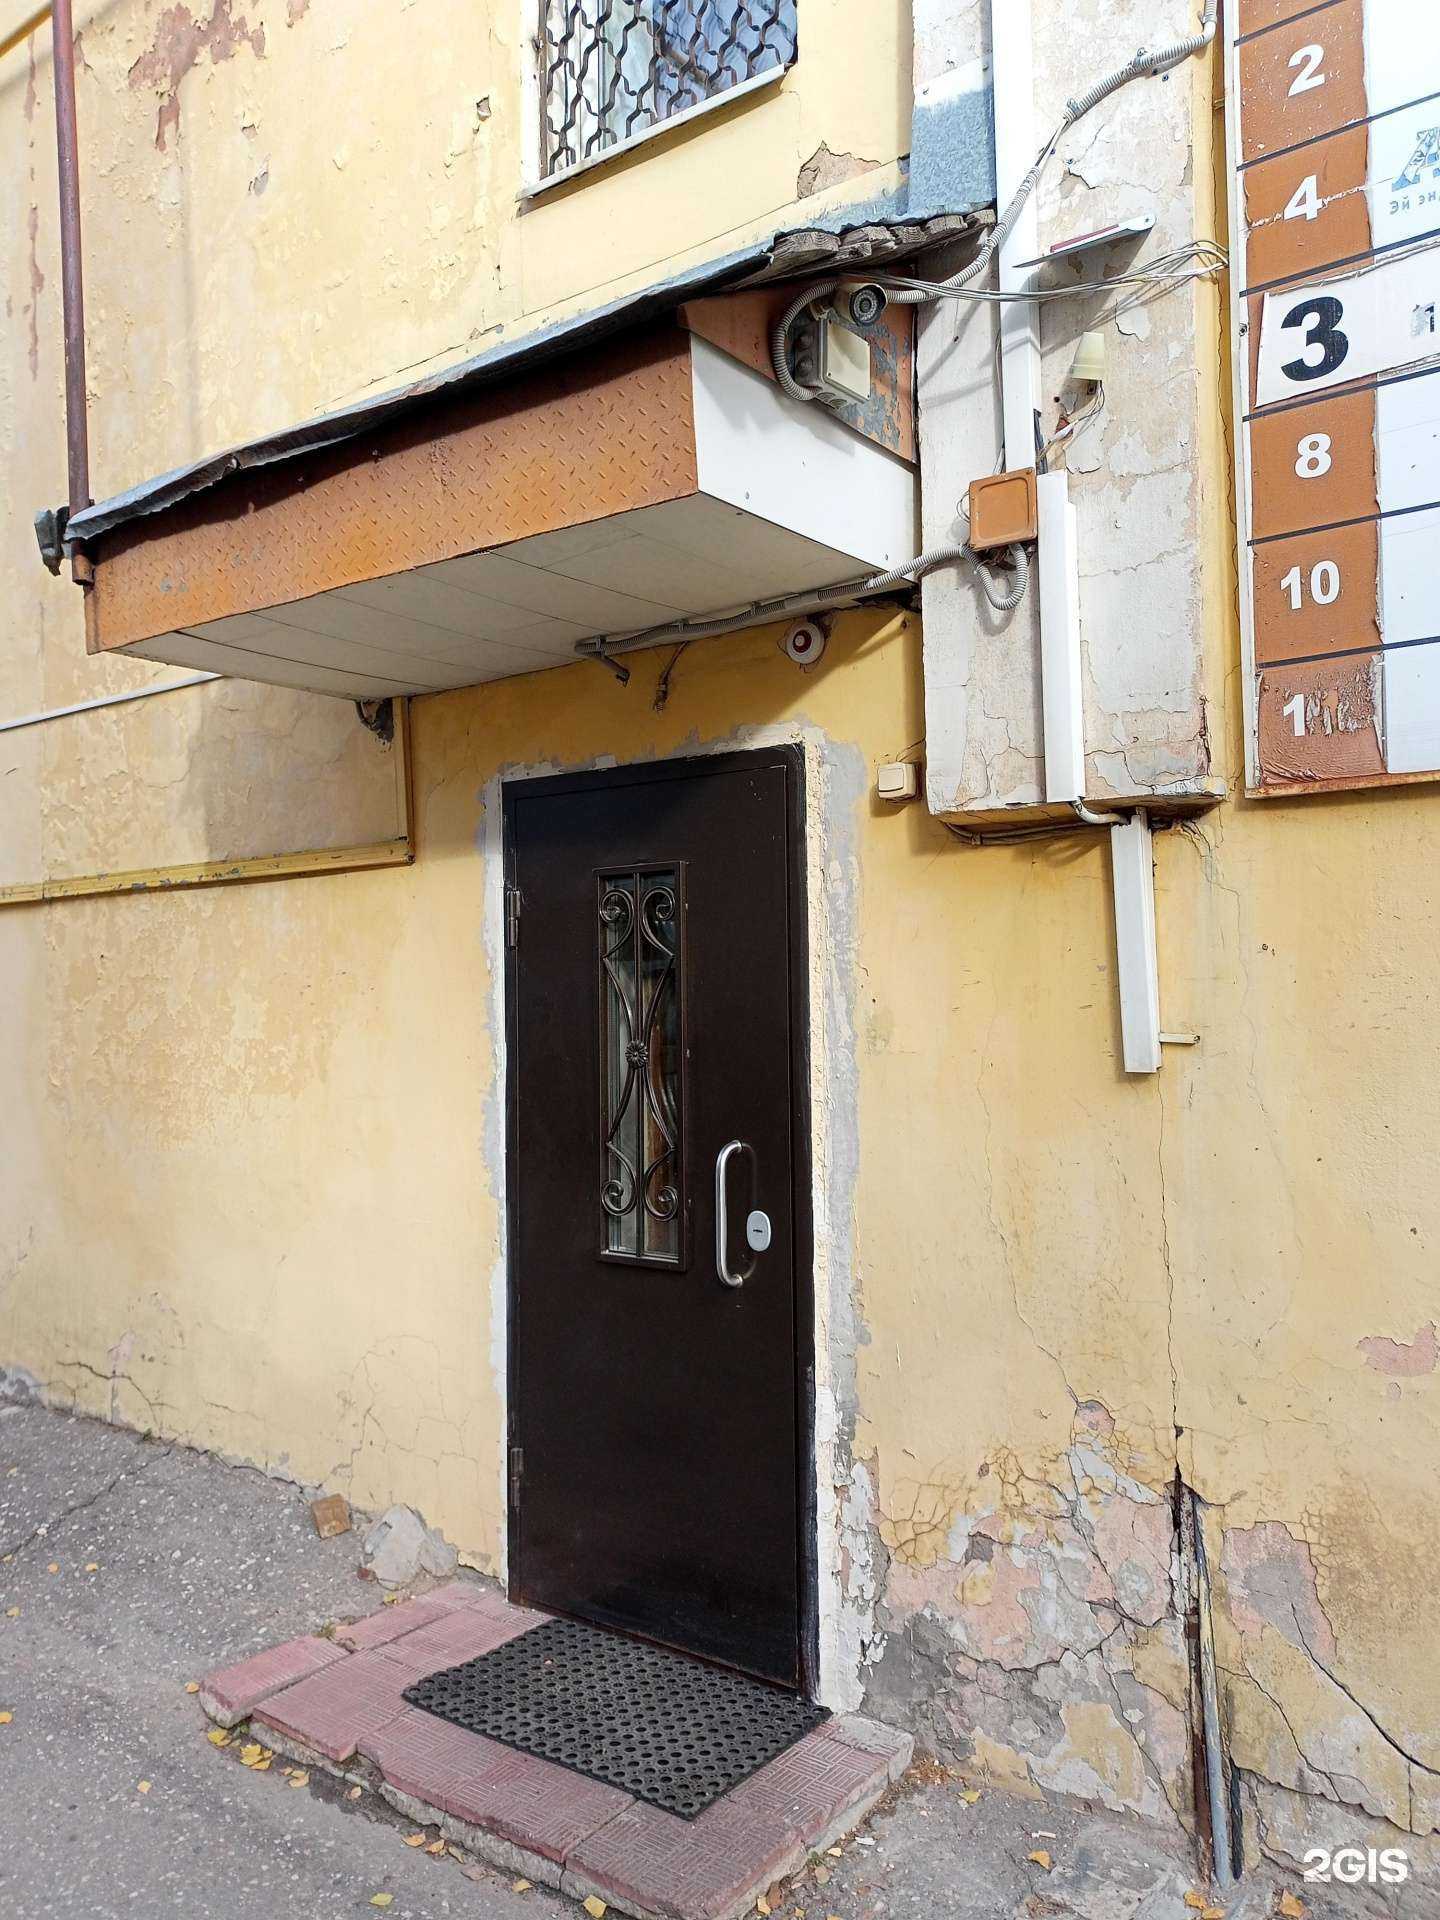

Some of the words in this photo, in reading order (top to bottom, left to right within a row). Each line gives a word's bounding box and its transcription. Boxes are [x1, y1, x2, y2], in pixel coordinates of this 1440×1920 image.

[1288, 44, 1325, 97] 2
[1284, 175, 1323, 221] 4
[1280, 296, 1349, 381] 3
[1294, 433, 1332, 479] 8
[1280, 560, 1341, 610] 10
